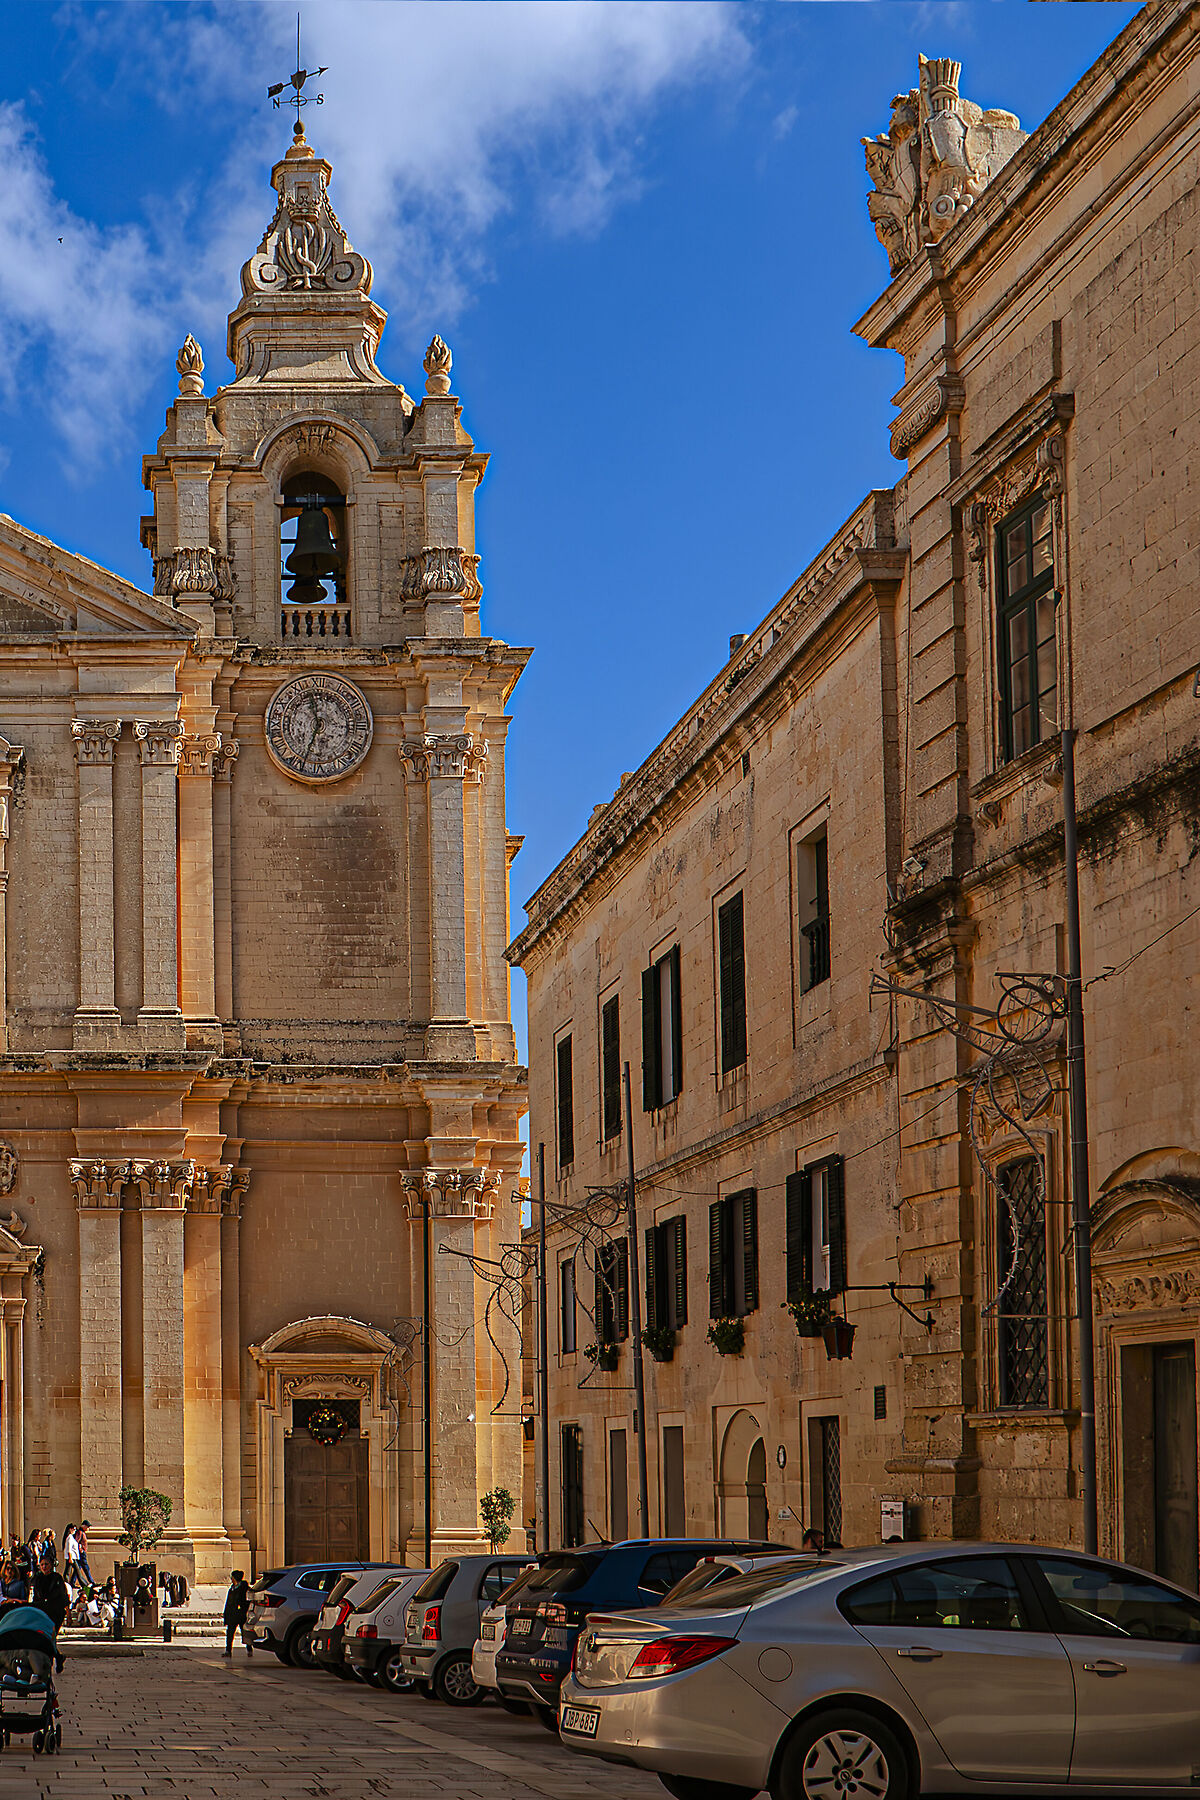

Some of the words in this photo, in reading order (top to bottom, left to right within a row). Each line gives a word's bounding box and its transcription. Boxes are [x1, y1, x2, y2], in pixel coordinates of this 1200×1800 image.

[273, 97, 280, 109] N
[317, 94, 324, 105] S
[291, 682, 304, 694] XI
[312, 678, 326, 688] XII
[276, 700, 287, 709] X
[356, 721, 367, 731] III
[313, 763, 324, 773] VI
